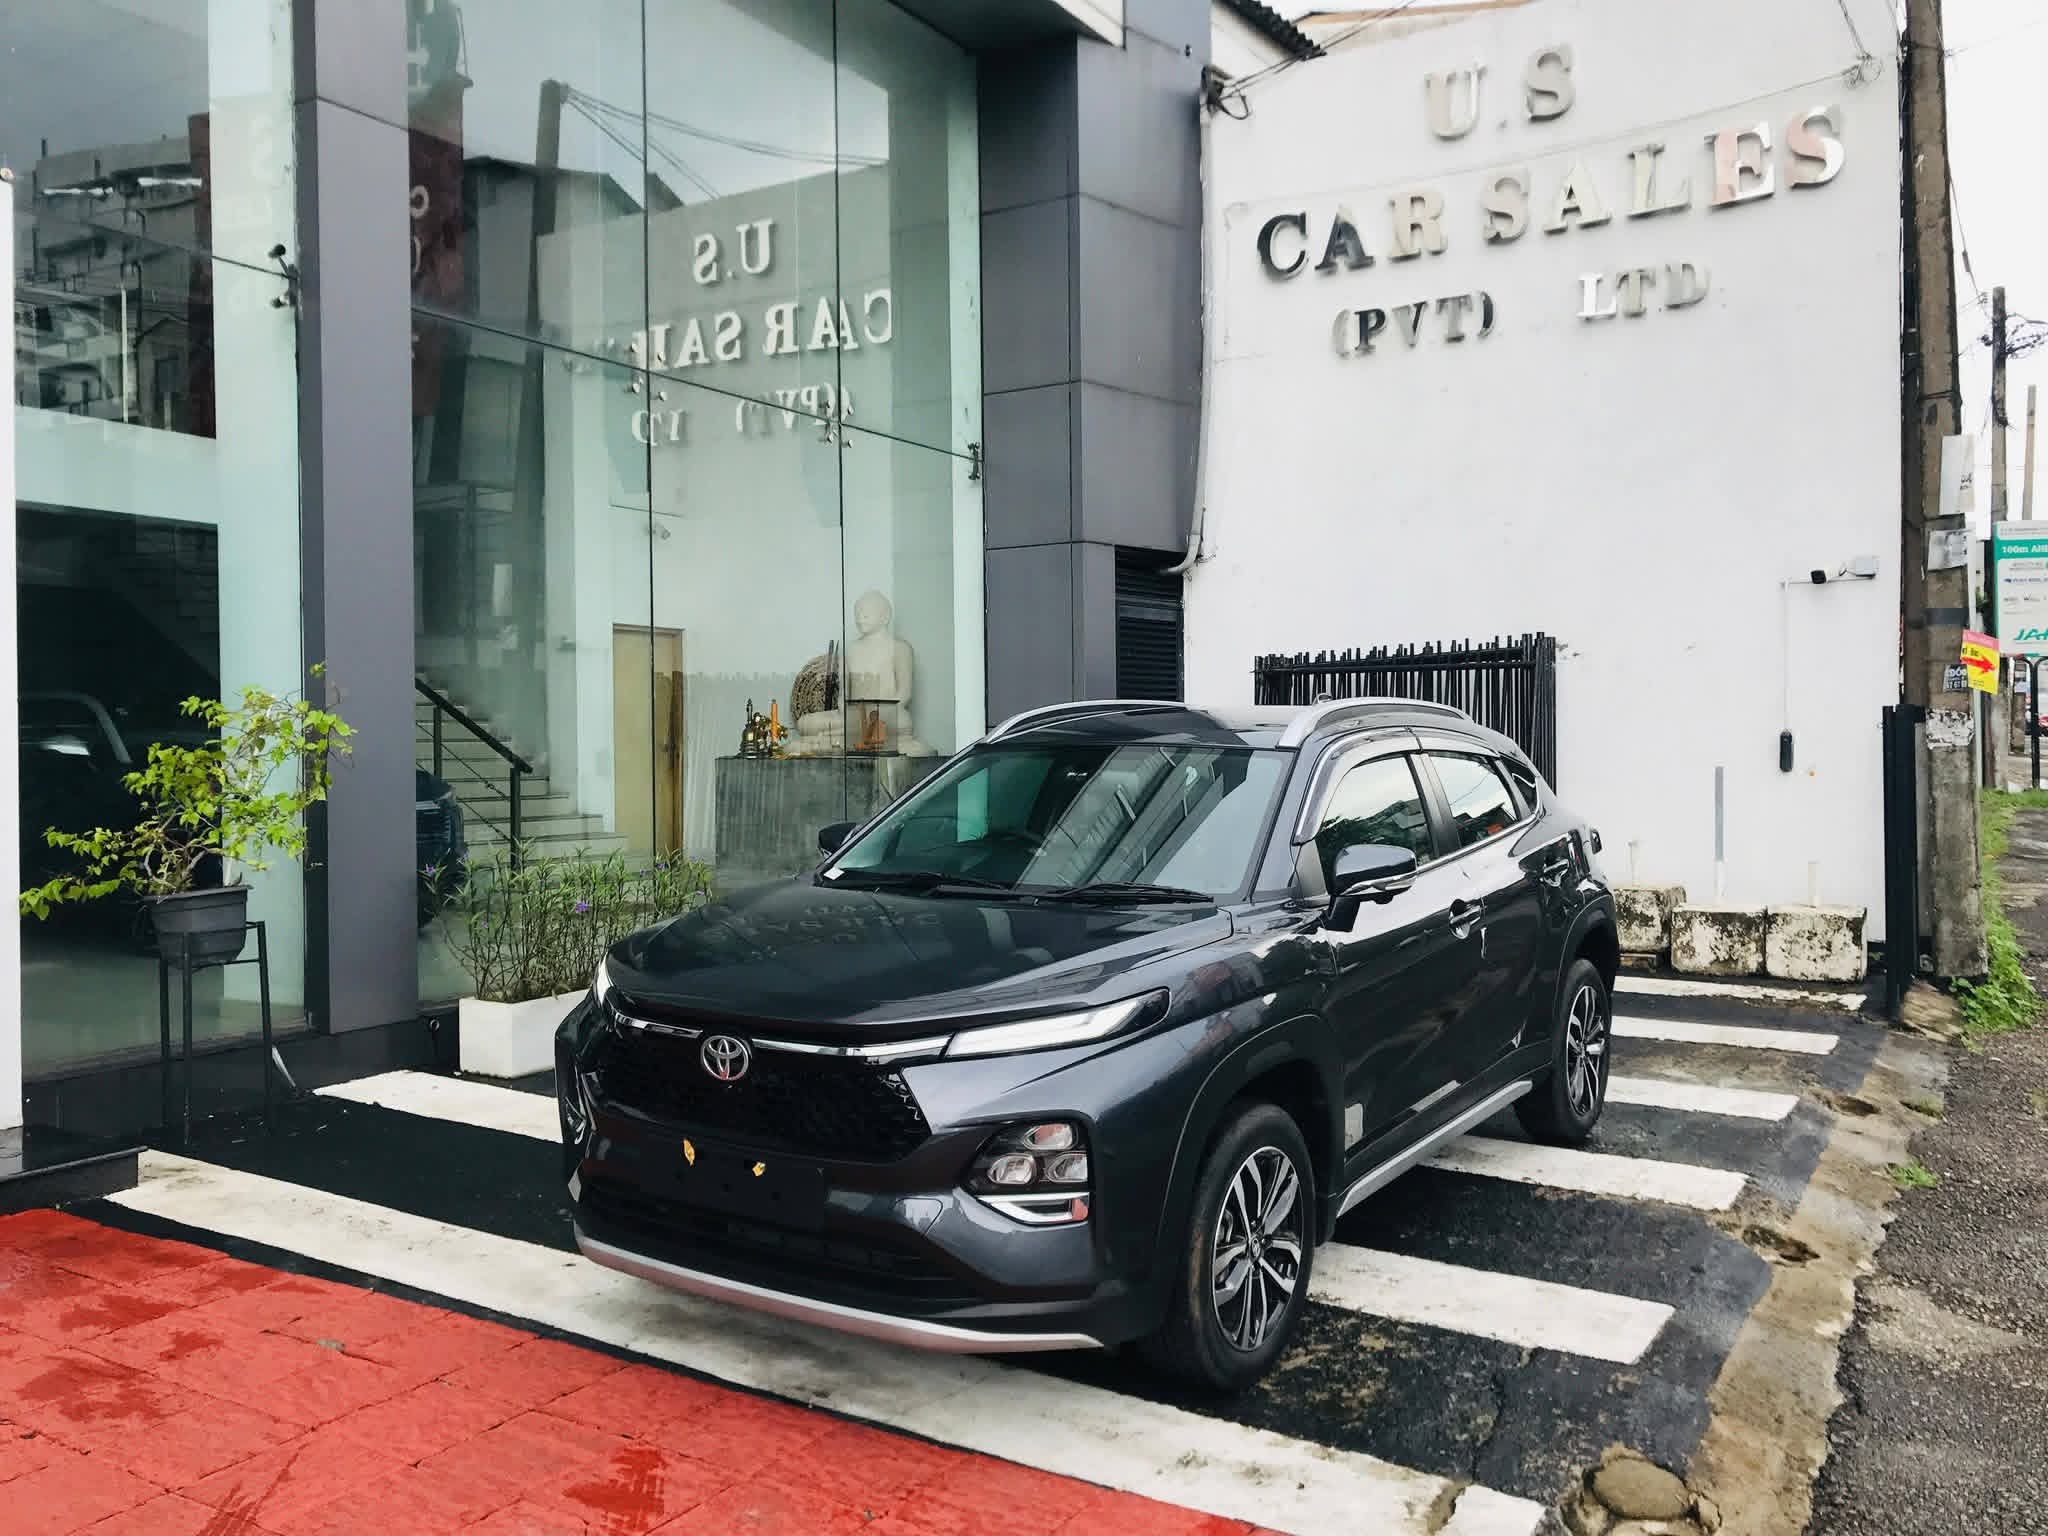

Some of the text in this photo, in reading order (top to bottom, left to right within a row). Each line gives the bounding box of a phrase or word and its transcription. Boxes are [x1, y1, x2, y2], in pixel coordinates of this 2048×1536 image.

[1257, 105, 1846, 281] CAR SALES
[1331, 263, 1711, 357] (PVT) LTD
